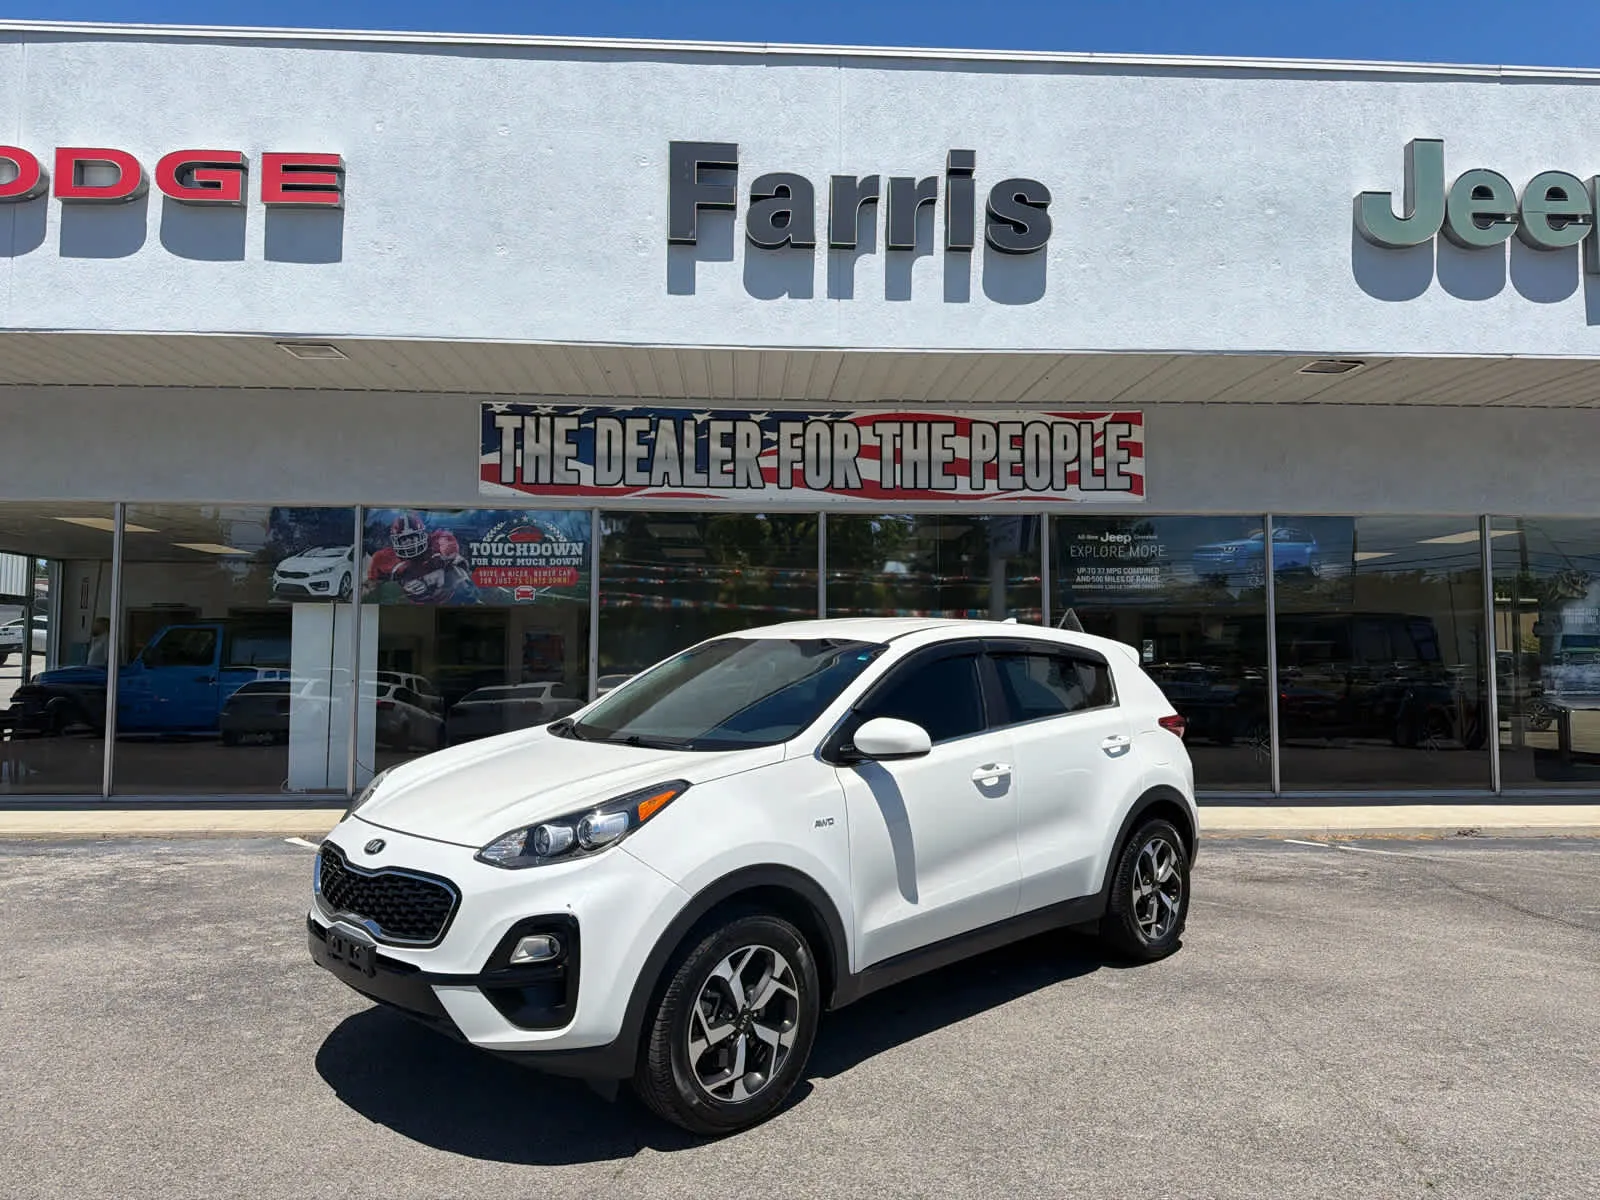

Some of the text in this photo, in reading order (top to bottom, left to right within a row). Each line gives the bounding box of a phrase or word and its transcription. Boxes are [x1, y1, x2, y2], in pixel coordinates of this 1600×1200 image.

[667, 141, 1052, 255] Farris
[1353, 138, 1600, 274] Jee
[495, 413, 1132, 491] THE DEALER FOR THE PEOPLE
[1100, 532, 1132, 545] Jeep
[469, 542, 584, 556] TOUCHDOWN
[1070, 545, 1168, 558] EXPLORE MORE
[471, 558, 583, 566] FOR NOT MUCH DOWN!
